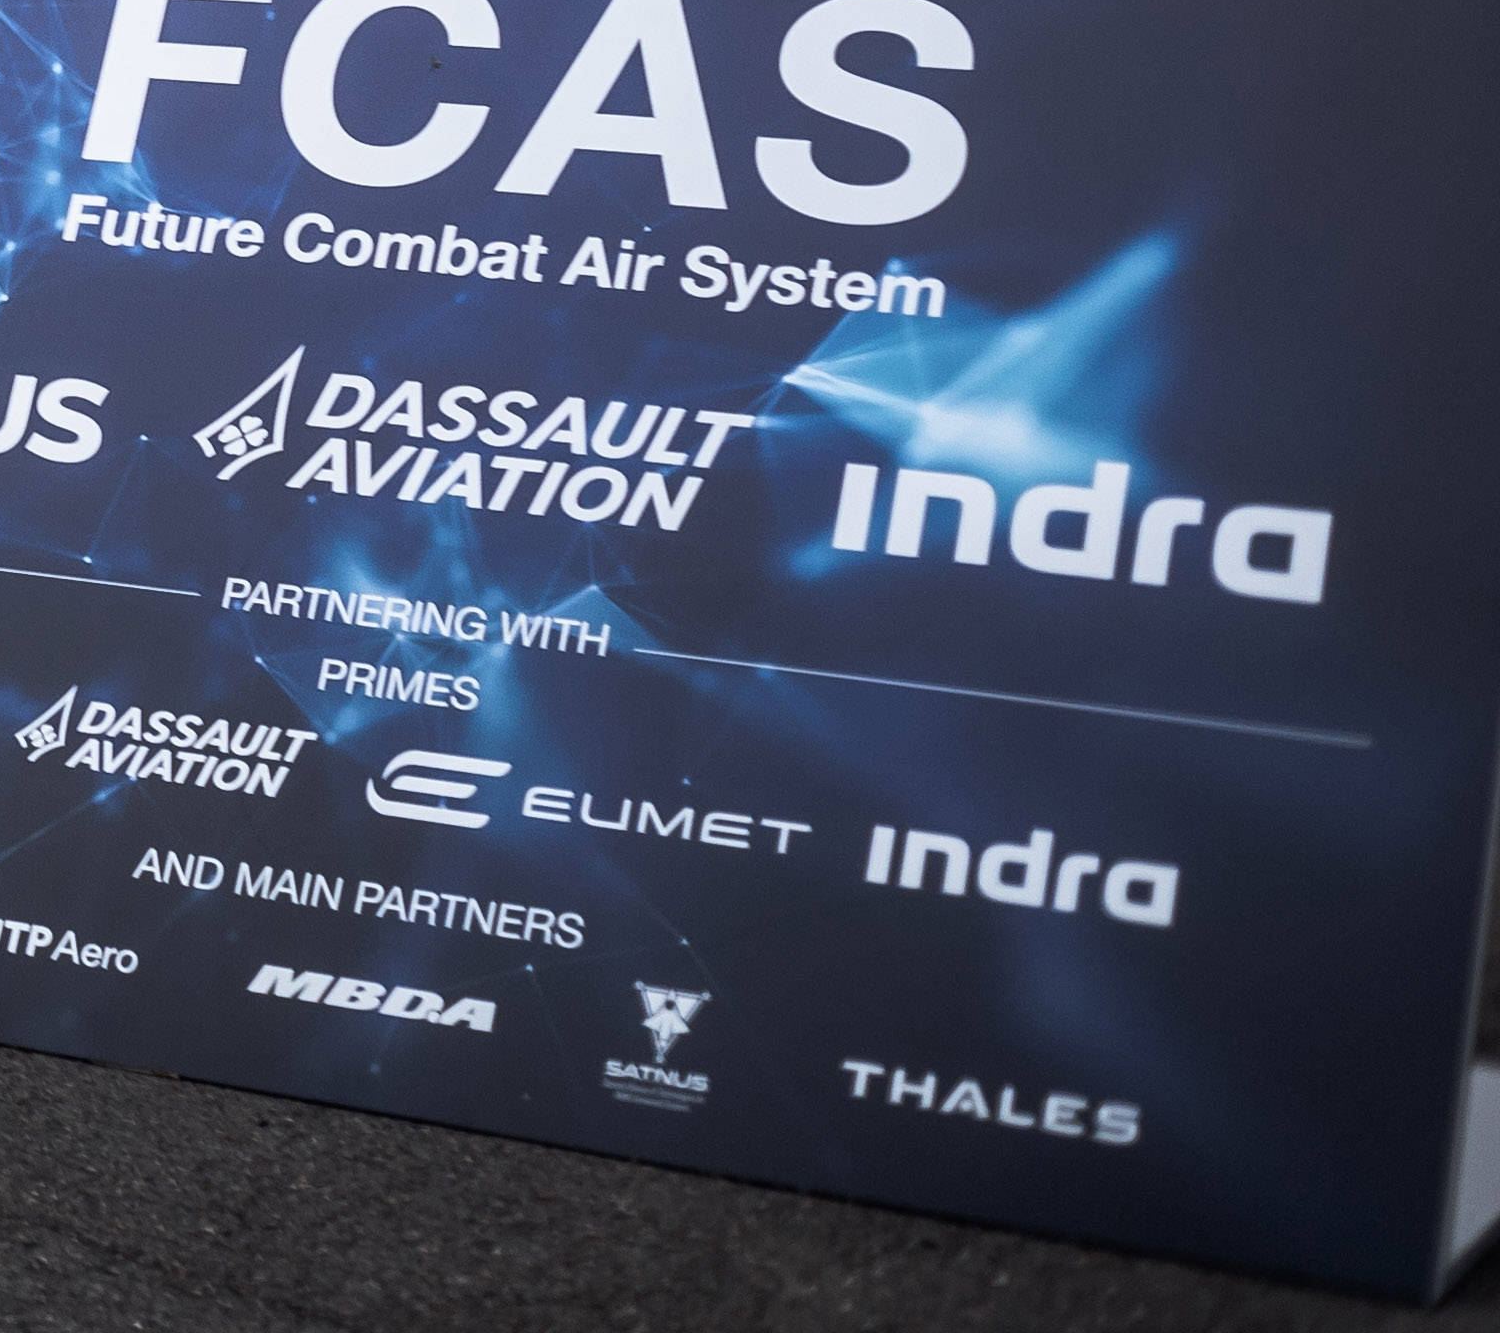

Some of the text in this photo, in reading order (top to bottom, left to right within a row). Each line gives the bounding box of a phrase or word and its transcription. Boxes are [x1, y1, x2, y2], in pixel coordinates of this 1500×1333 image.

[61, 192, 946, 318] Future Combat Air System
[305, 372, 756, 469] DASSAULT
[285, 437, 704, 532] AVIATION
[830, 460, 1333, 605] indra
[221, 576, 611, 658] PARTNERING WITH
[317, 657, 481, 712] PRIMES
[64, 738, 290, 799] AVIATION
[76, 700, 319, 764] DASSAULT
[521, 785, 813, 855] EUMET
[131, 847, 586, 950] AND MAIN PARTNERS
[865, 824, 1180, 927] indra
[840, 1058, 1142, 1145] THALES
